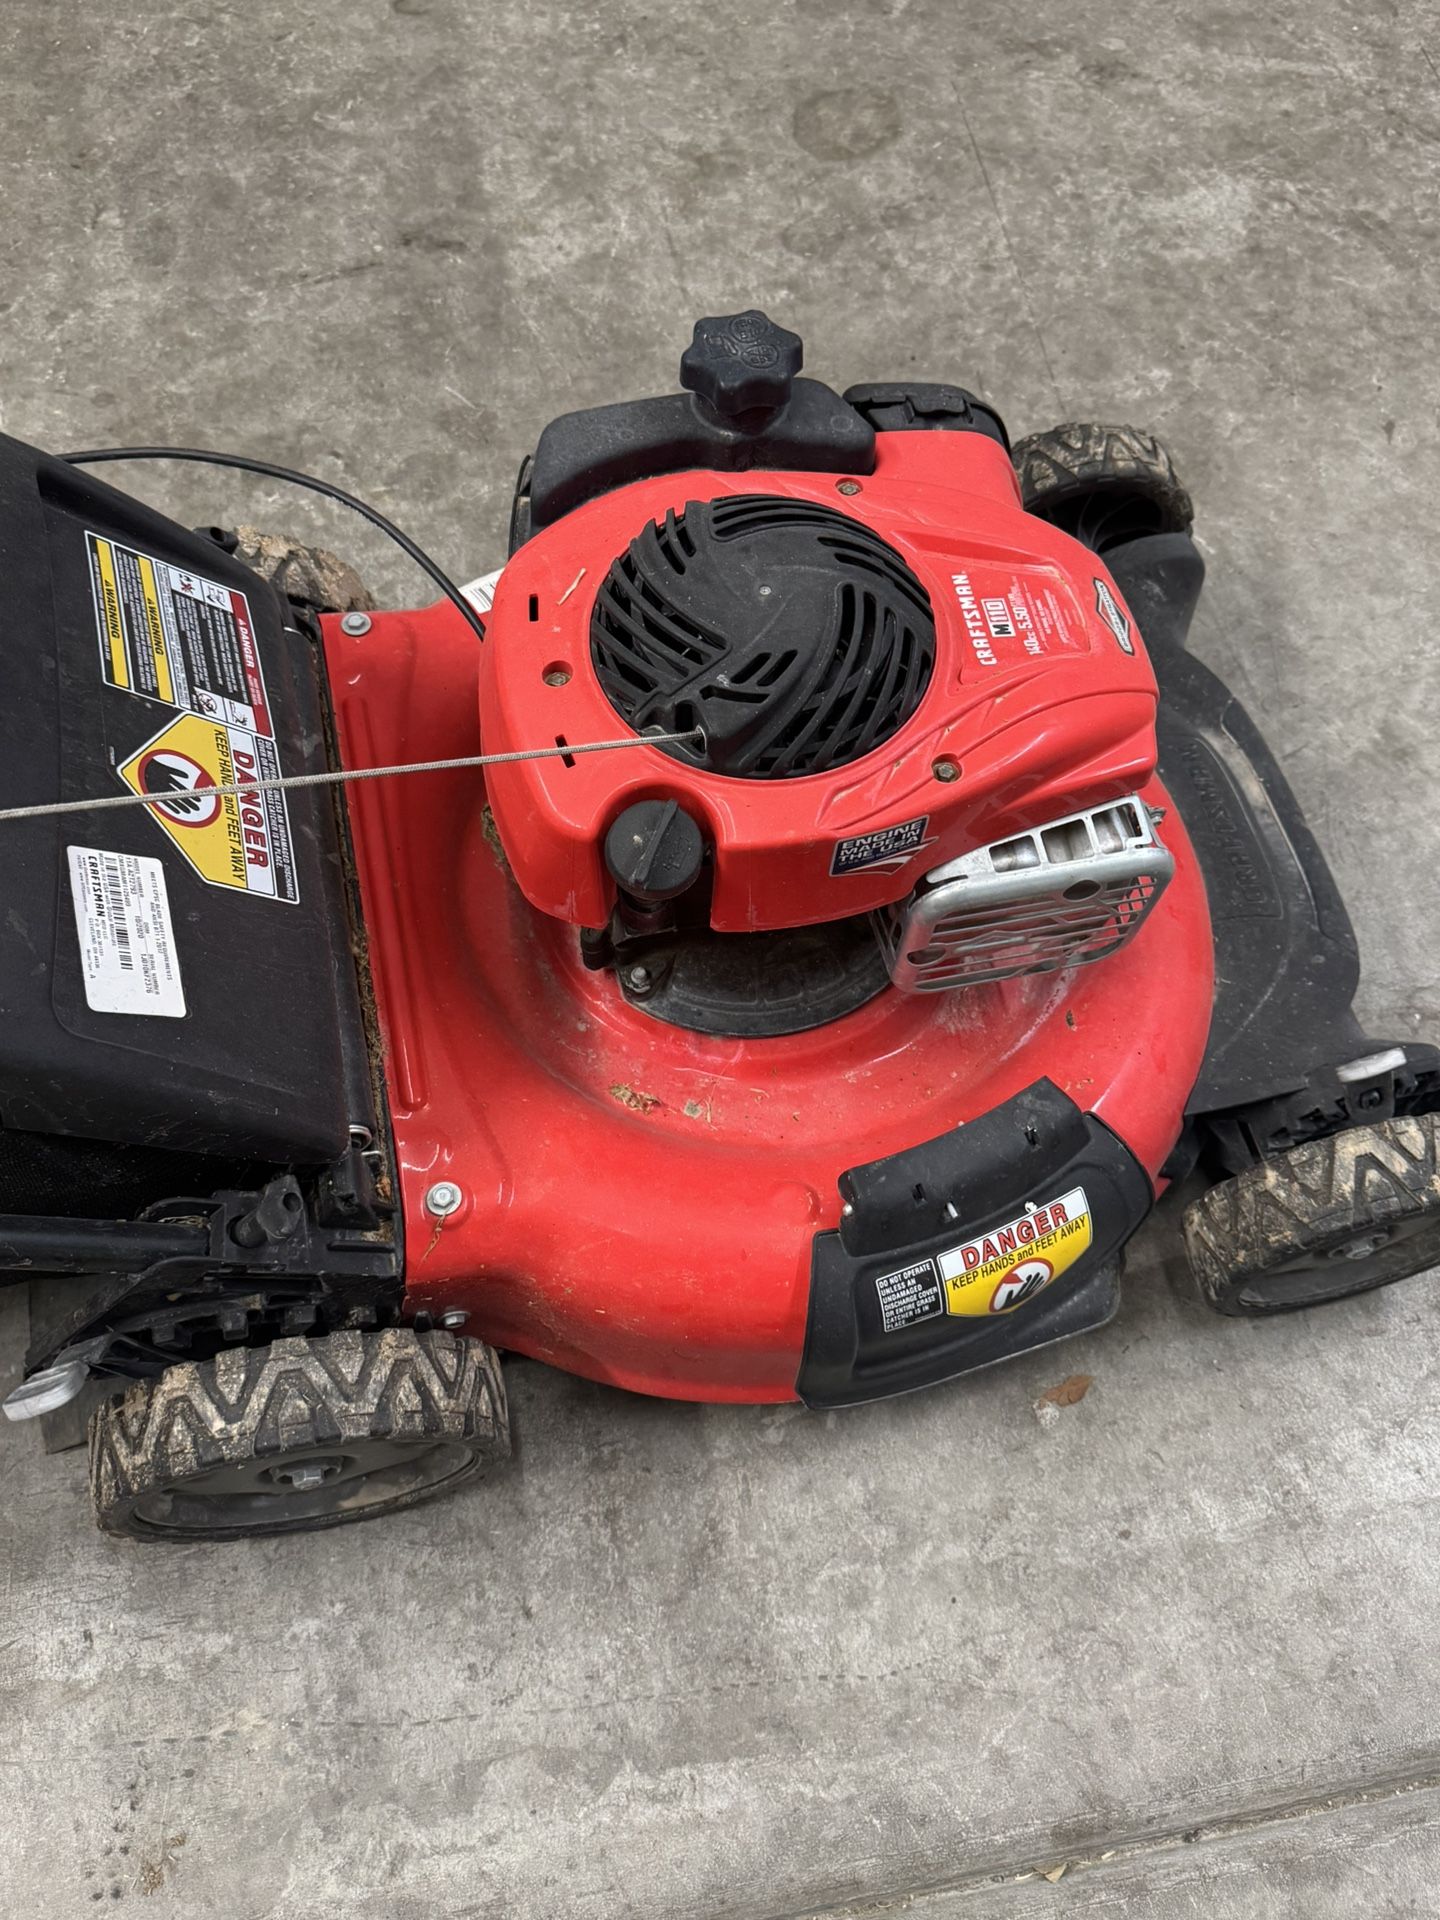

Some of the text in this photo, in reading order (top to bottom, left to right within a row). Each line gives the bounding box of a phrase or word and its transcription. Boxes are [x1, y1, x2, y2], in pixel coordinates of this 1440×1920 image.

[105, 588, 120, 639] WARNING
[951, 574, 997, 665] CRAFTSMAN
[986, 601, 1012, 636] M110
[1012, 606, 1033, 629] 5.50
[148, 606, 164, 655] WARNING
[239, 626, 254, 668] DANGER
[214, 729, 229, 758] KEEP
[257, 738, 267, 757] COVER
[265, 741, 272, 750] DO
[260, 757, 268, 766] OR
[266, 750, 275, 763] NOT
[223, 795, 237, 816] and
[232, 749, 269, 868] DANGER
[273, 790, 283, 813] UNLESS
[268, 804, 278, 831] CATCHER
[277, 814, 283, 823] AN
[226, 817, 241, 846] FEET
[273, 839, 280, 847] IN
[278, 824, 289, 863] UNDAMAGED
[840, 838, 895, 856] MADE
[902, 828, 920, 839] IN
[842, 821, 921, 849] ENGINE
[839, 850, 874, 862] THE
[880, 836, 918, 852] USA
[229, 846, 245, 881] AWAY
[88, 855, 105, 917] CRAFTSMAN
[150, 871, 158, 888] MEETS
[283, 864, 294, 899] DISCHARGE
[152, 889, 160, 902] CPSC
[135, 915, 145, 939] 10/2020
[162, 941, 173, 980] REQUIREMENTS
[152, 973, 160, 995] NUMBER
[960, 1202, 1069, 1271] DANGER
[951, 1215, 1085, 1290] KEEP HANDS and FEET AWAY
[878, 1263, 931, 1288] DO NOT OPERATE
[880, 1278, 916, 1296] UNLESS AN
[882, 1284, 922, 1304] UNDAMAGED
[884, 1286, 937, 1311] DISCHARGE COVER
[885, 1295, 935, 1318] OR ENTIRE GRASS
[886, 1310, 913, 1324] CATCHER
